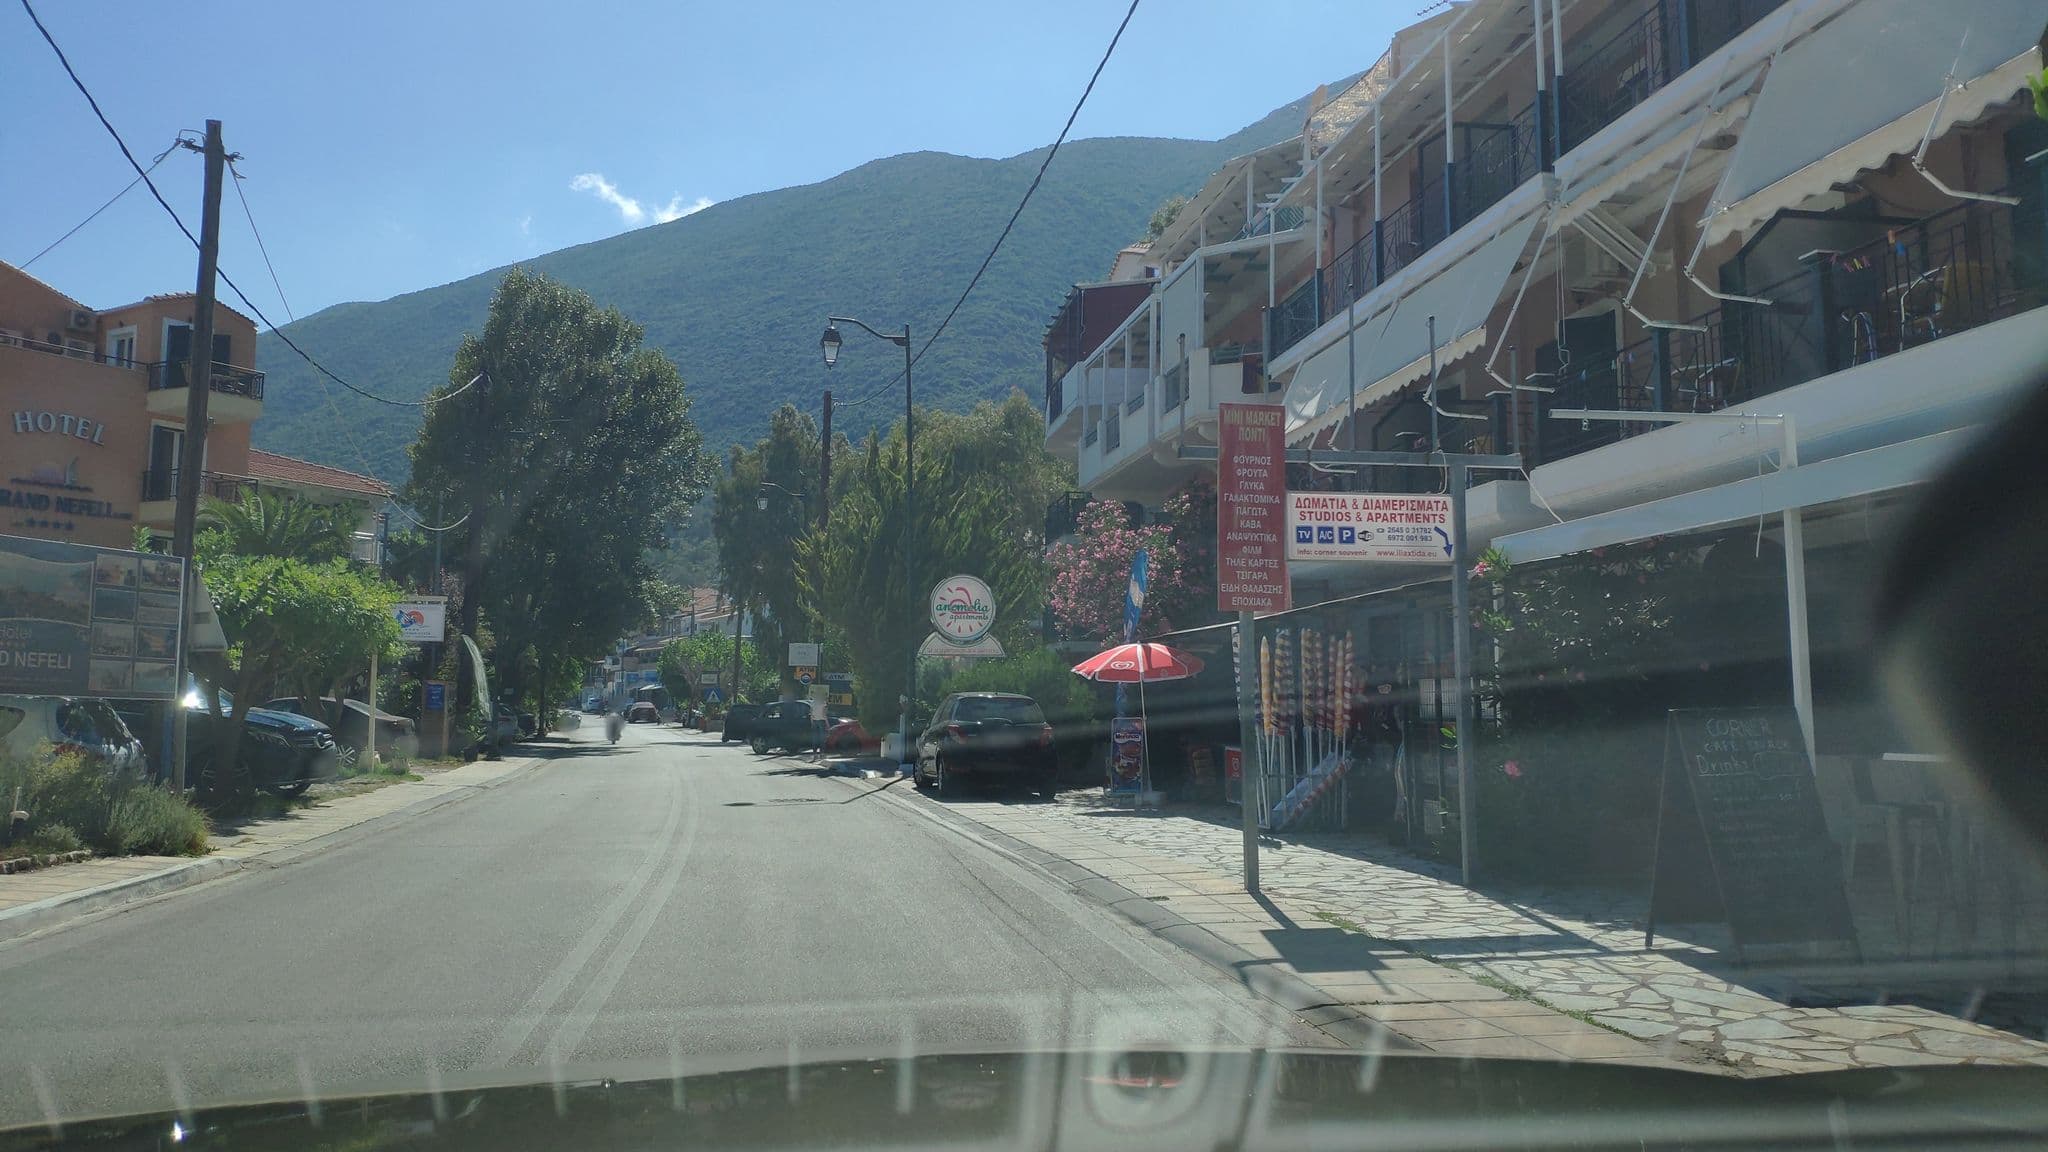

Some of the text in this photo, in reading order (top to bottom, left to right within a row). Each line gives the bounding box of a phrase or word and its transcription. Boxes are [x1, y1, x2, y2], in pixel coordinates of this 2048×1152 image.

[1224, 409, 1281, 427] MINI MARKET
[13, 410, 105, 447] HOTEL
[1233, 455, 1272, 465] ΦΟΥΡΝΟΣ
[1236, 468, 1268, 478] ΦΡΟΥΤΑ
[1239, 480, 1265, 490] ΓΛΥΚΑ
[1295, 497, 1449, 512] ΔΩΜΑΤΙΑ & ΔΙΑΜΕΡΙΣΜΑΤΑ
[1236, 506, 1268, 516] ΠΑΓΩΤΑ
[1299, 511, 1446, 524] STUDIOS & APARTMENTS
[1240, 519, 1262, 529] ΚΑΒΑ
[1226, 532, 1278, 543] ΑΝΑΨΥΚΤΙΚΑ
[1298, 530, 1310, 539] TV
[1319, 530, 1333, 540] A/C
[1342, 530, 1352, 540] P
[1242, 545, 1262, 555] ΦΙΛΜ
[1225, 557, 1280, 569] ΤΗΛΕ ΚΑΡΤΕΣ
[1235, 570, 1268, 581] ΤΣΙΓΑΡΑ
[1220, 583, 1284, 594] ΕΙΔΗ ΘΑΛΑΣΣΗΣ
[1232, 596, 1273, 607] ΕΠΟΧΙΑΚΑ
[15, 651, 72, 669] NEFELI
